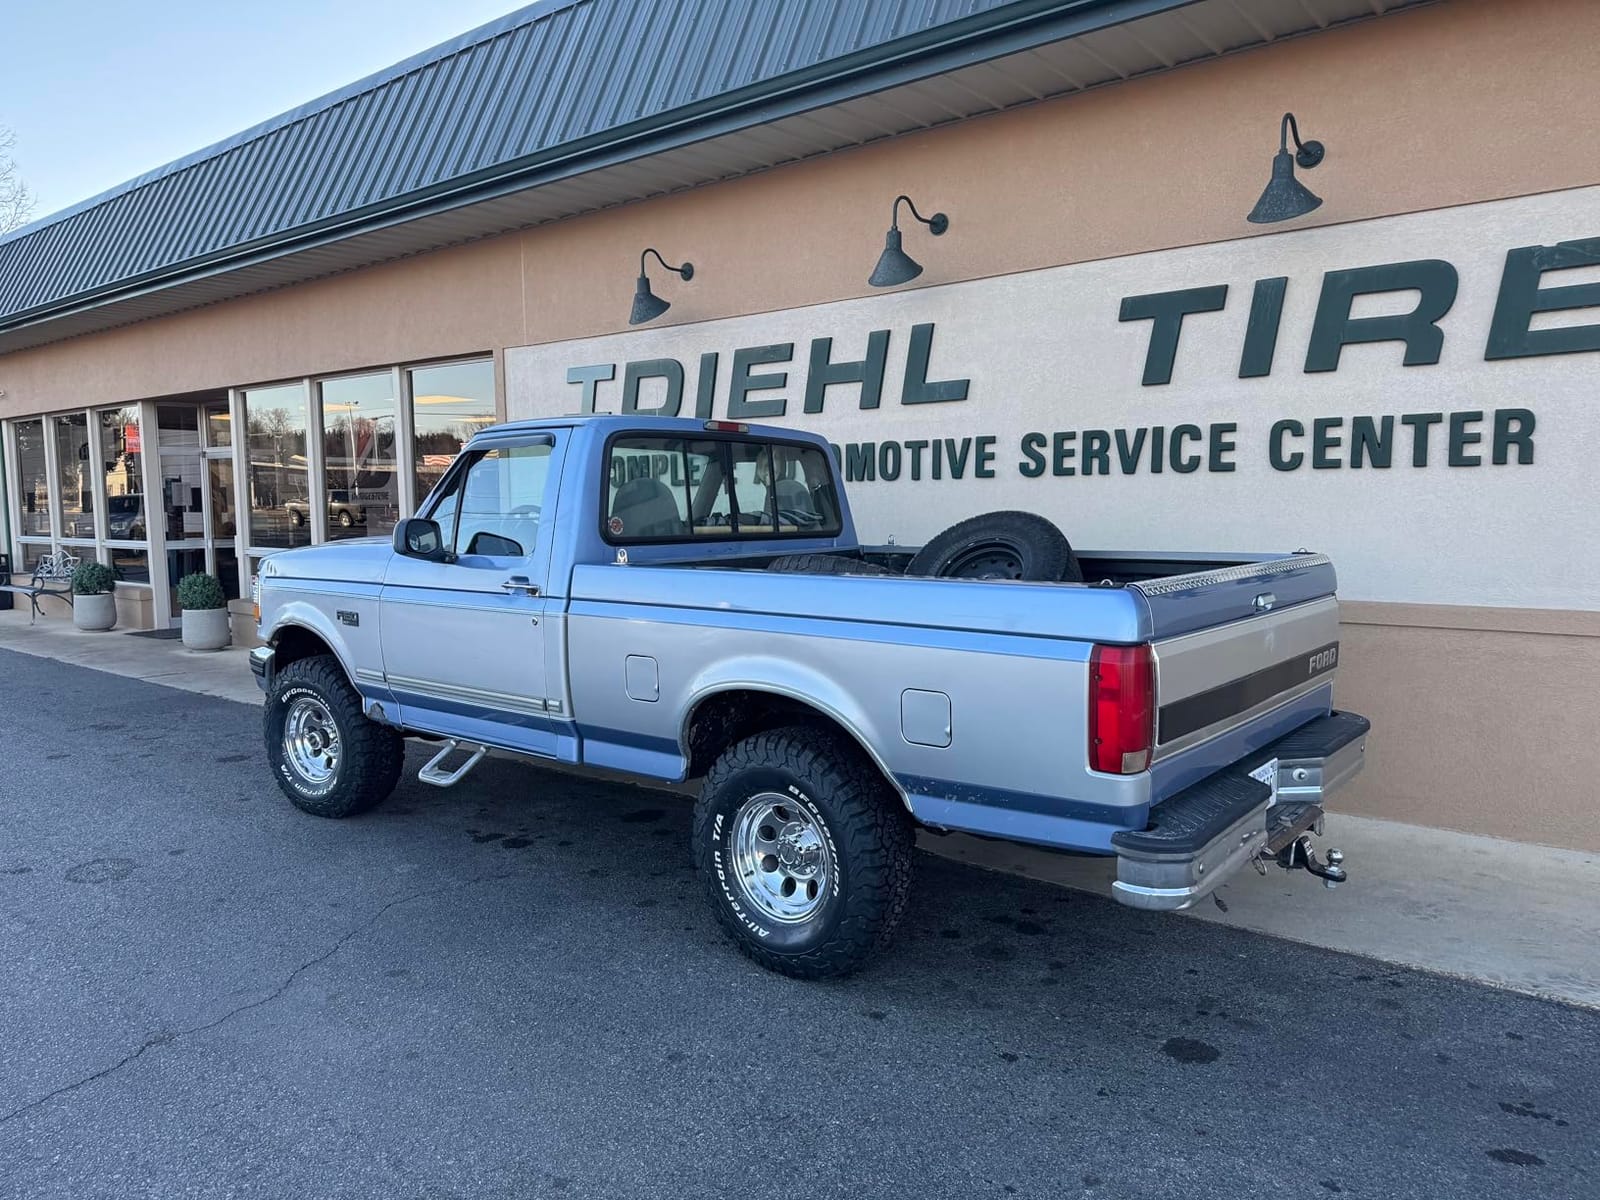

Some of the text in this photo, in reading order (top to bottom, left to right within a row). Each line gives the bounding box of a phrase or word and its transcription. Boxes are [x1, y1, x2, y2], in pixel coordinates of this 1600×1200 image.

[1118, 236, 1600, 386] TIRE
[1018, 422, 1237, 478] SERVICE
[1268, 408, 1536, 472] CENTER
[1308, 647, 1337, 675] FORD
[712, 812, 725, 842] T/A
[787, 784, 840, 898] BFGoodrich
